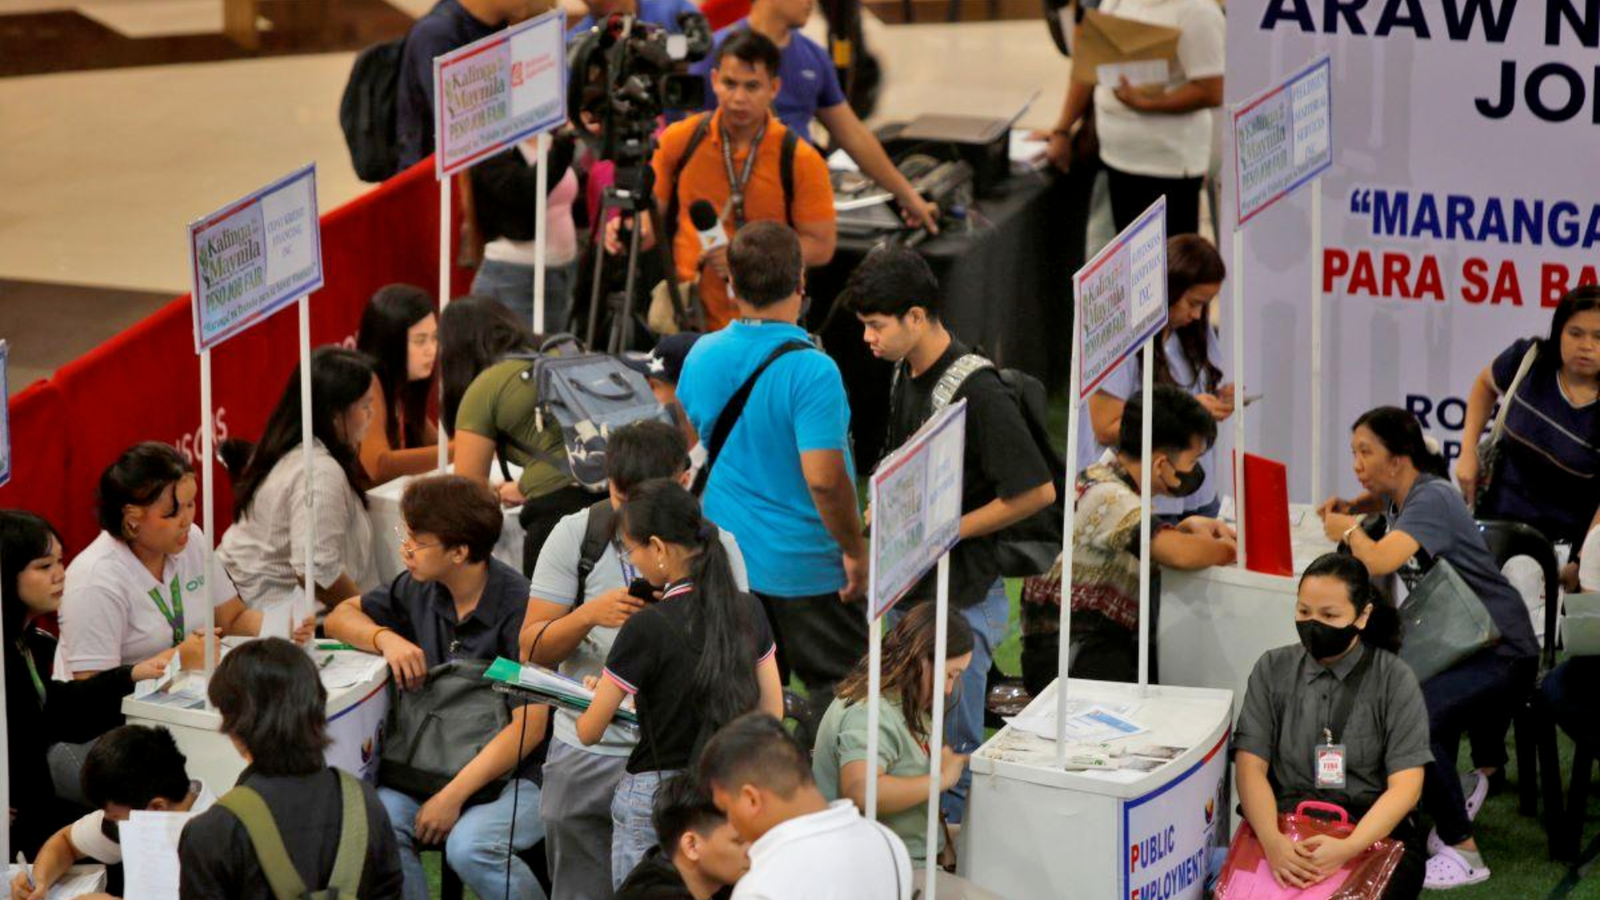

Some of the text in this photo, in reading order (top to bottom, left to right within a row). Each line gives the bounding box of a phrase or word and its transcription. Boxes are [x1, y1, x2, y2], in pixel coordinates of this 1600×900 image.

[1474, 60, 1600, 125] JO
[207, 227, 251, 259] Kalinga
[1350, 188, 1600, 249] “MARANGA
[209, 242, 260, 282] Maynila
[1322, 248, 1445, 301] PARA
[1461, 257, 1523, 307] SA
[205, 288, 226, 313] PESO
[226, 278, 243, 302] JOB
[244, 267, 263, 292] FAIR
[1131, 824, 1175, 873] PUBLIC
